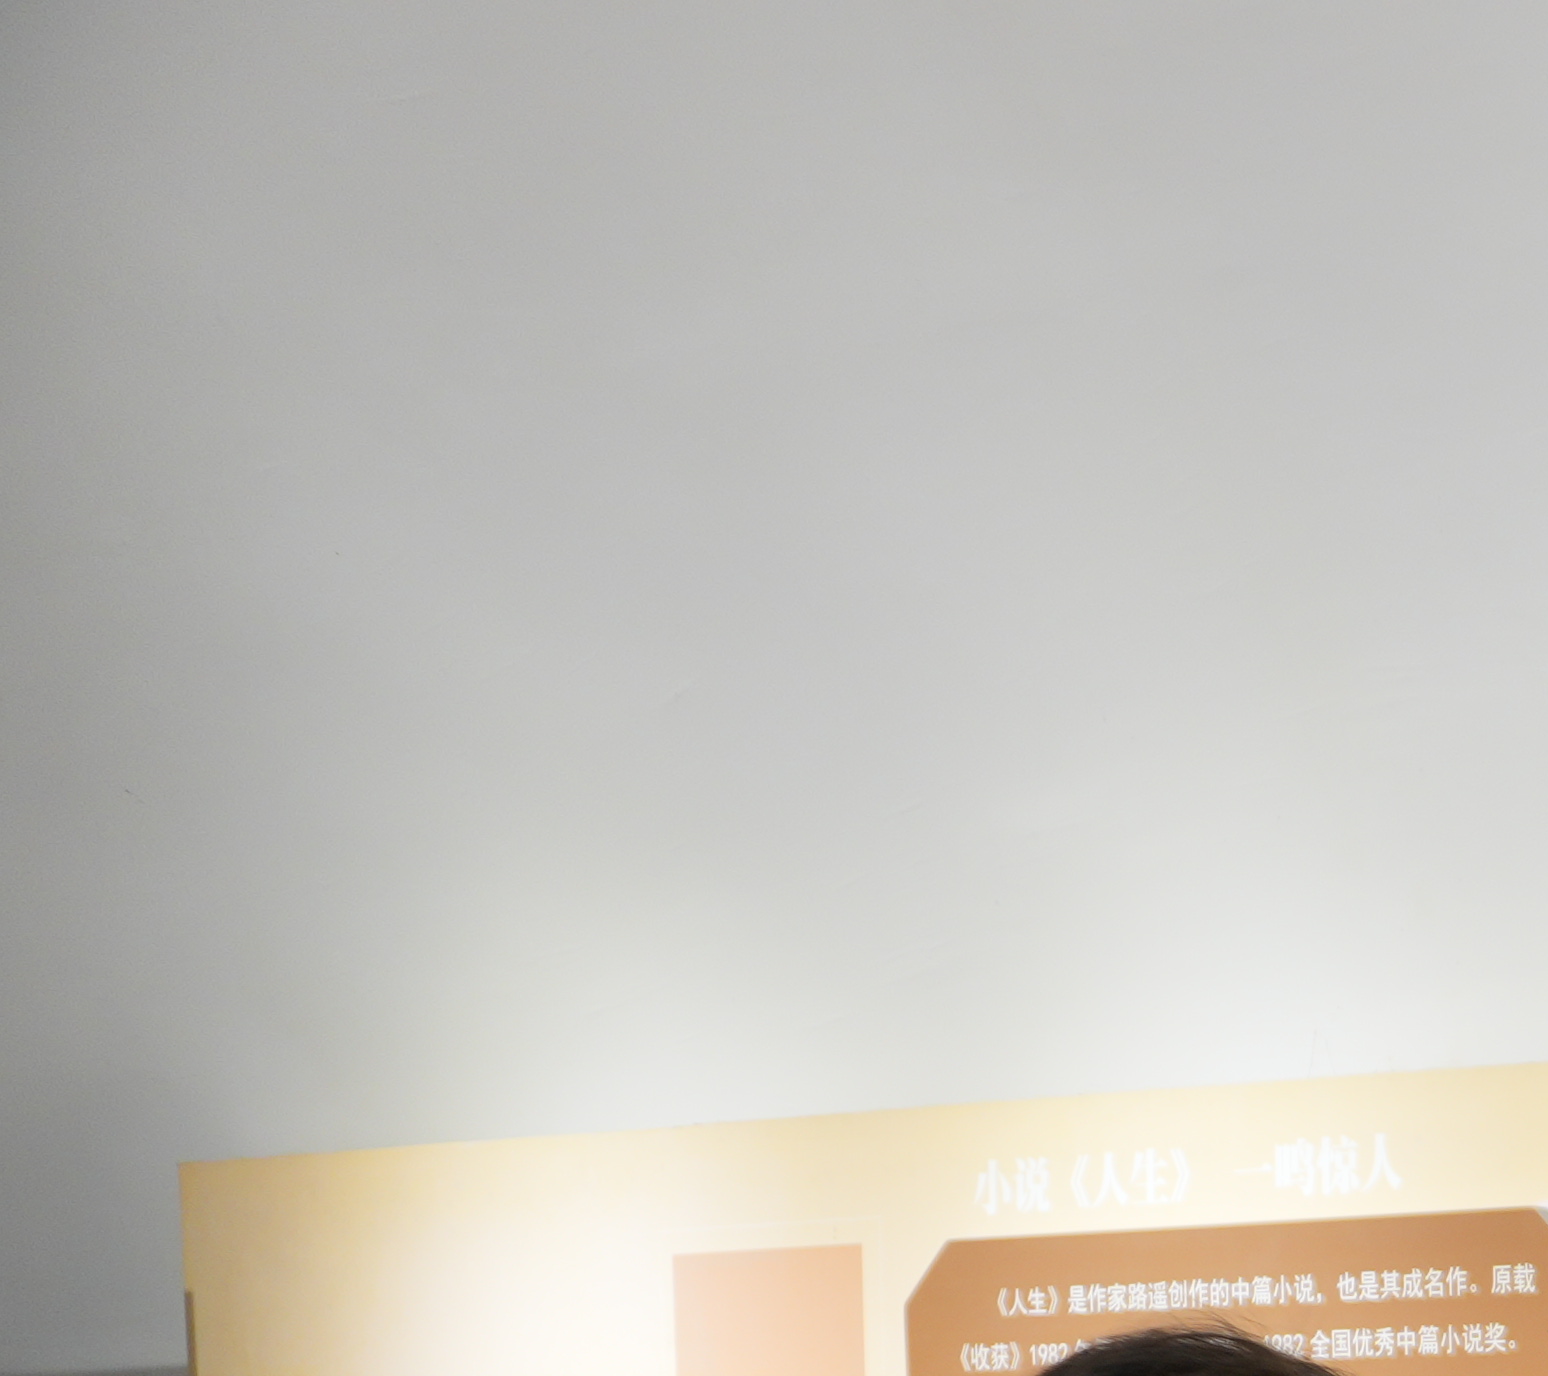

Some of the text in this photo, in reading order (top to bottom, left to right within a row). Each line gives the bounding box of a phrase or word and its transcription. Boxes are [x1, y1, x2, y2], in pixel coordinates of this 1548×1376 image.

[973, 1131, 1403, 1216] 小说《人生》 一鸣惊人
